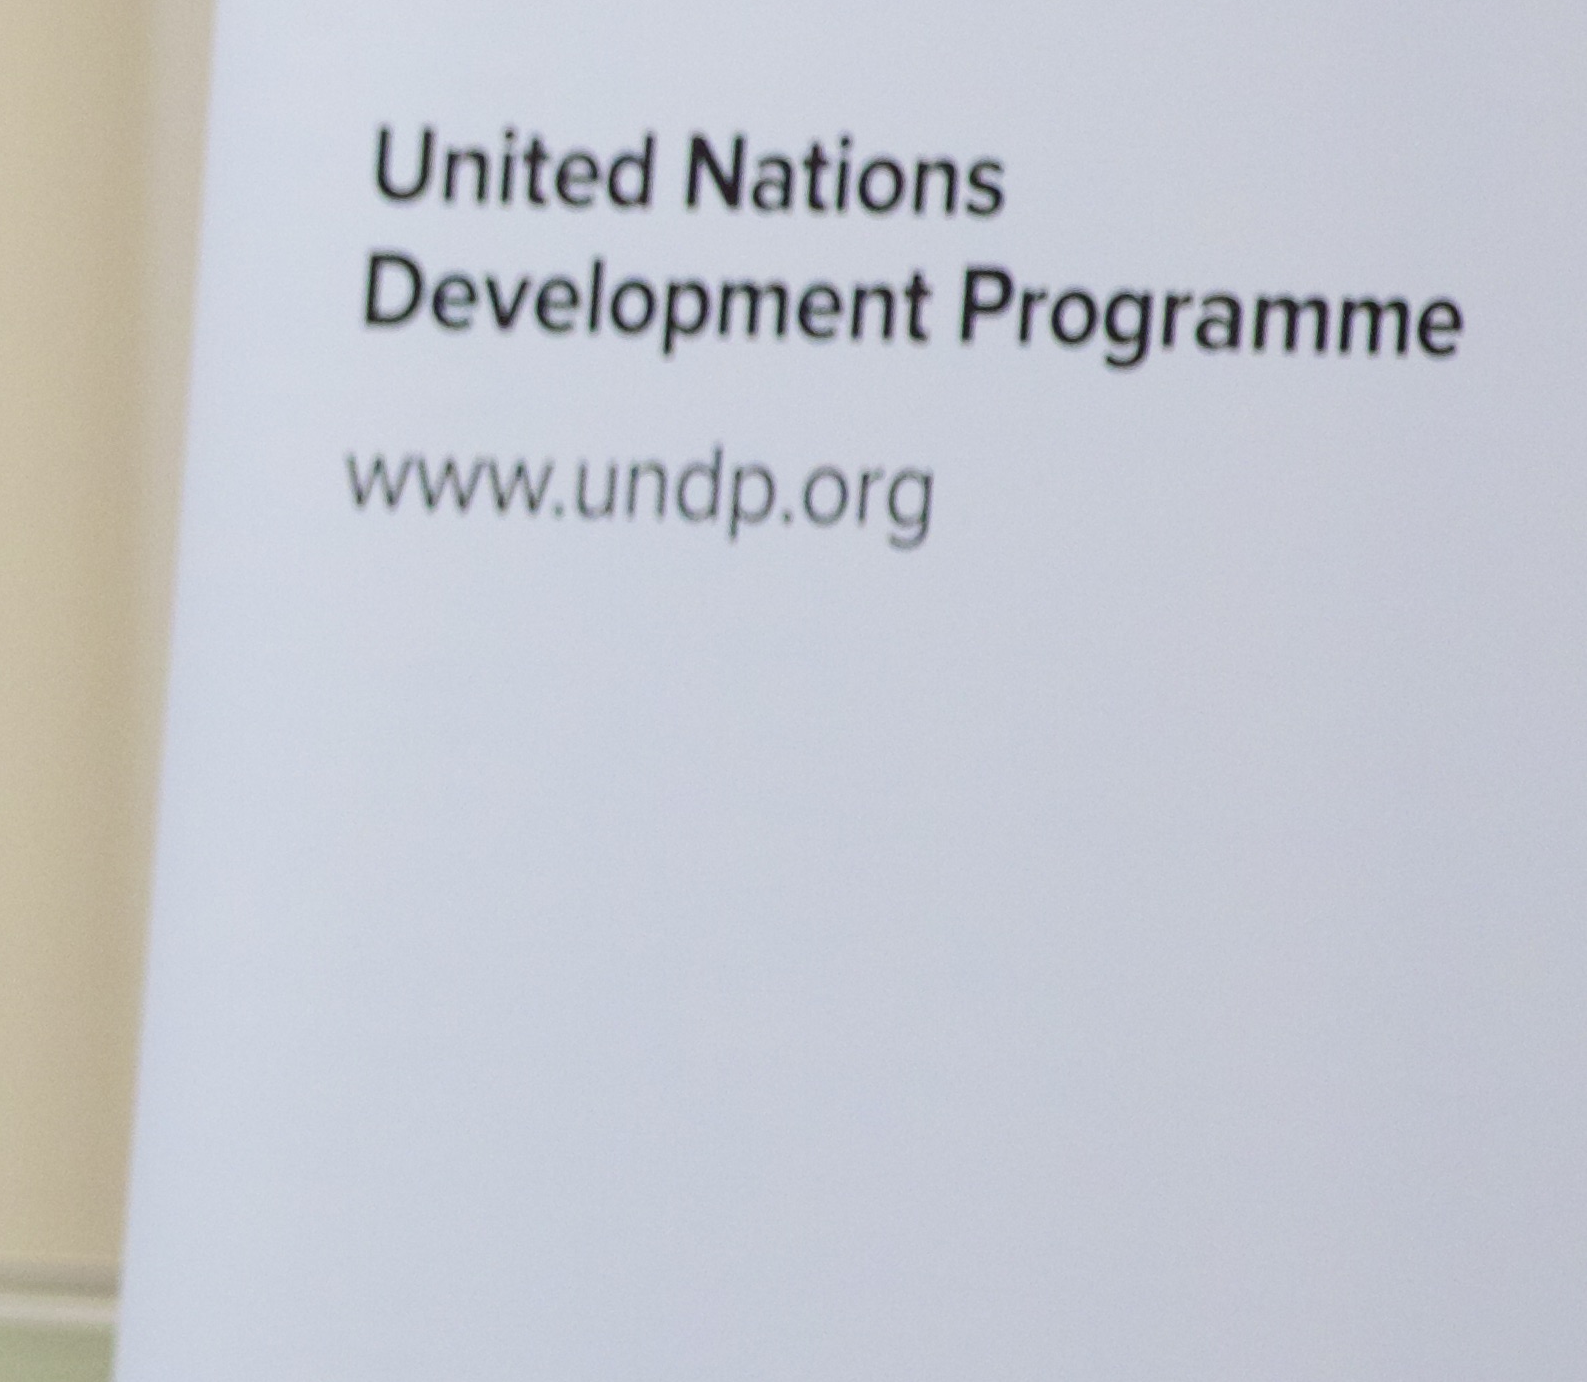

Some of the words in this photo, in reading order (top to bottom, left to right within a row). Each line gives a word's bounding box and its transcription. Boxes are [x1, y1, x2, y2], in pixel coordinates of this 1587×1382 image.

[374, 125, 657, 210] United
[683, 132, 1006, 219] Nations
[363, 250, 934, 358] Development
[958, 264, 1465, 372] Programme
[346, 446, 935, 551] www.undp.org
